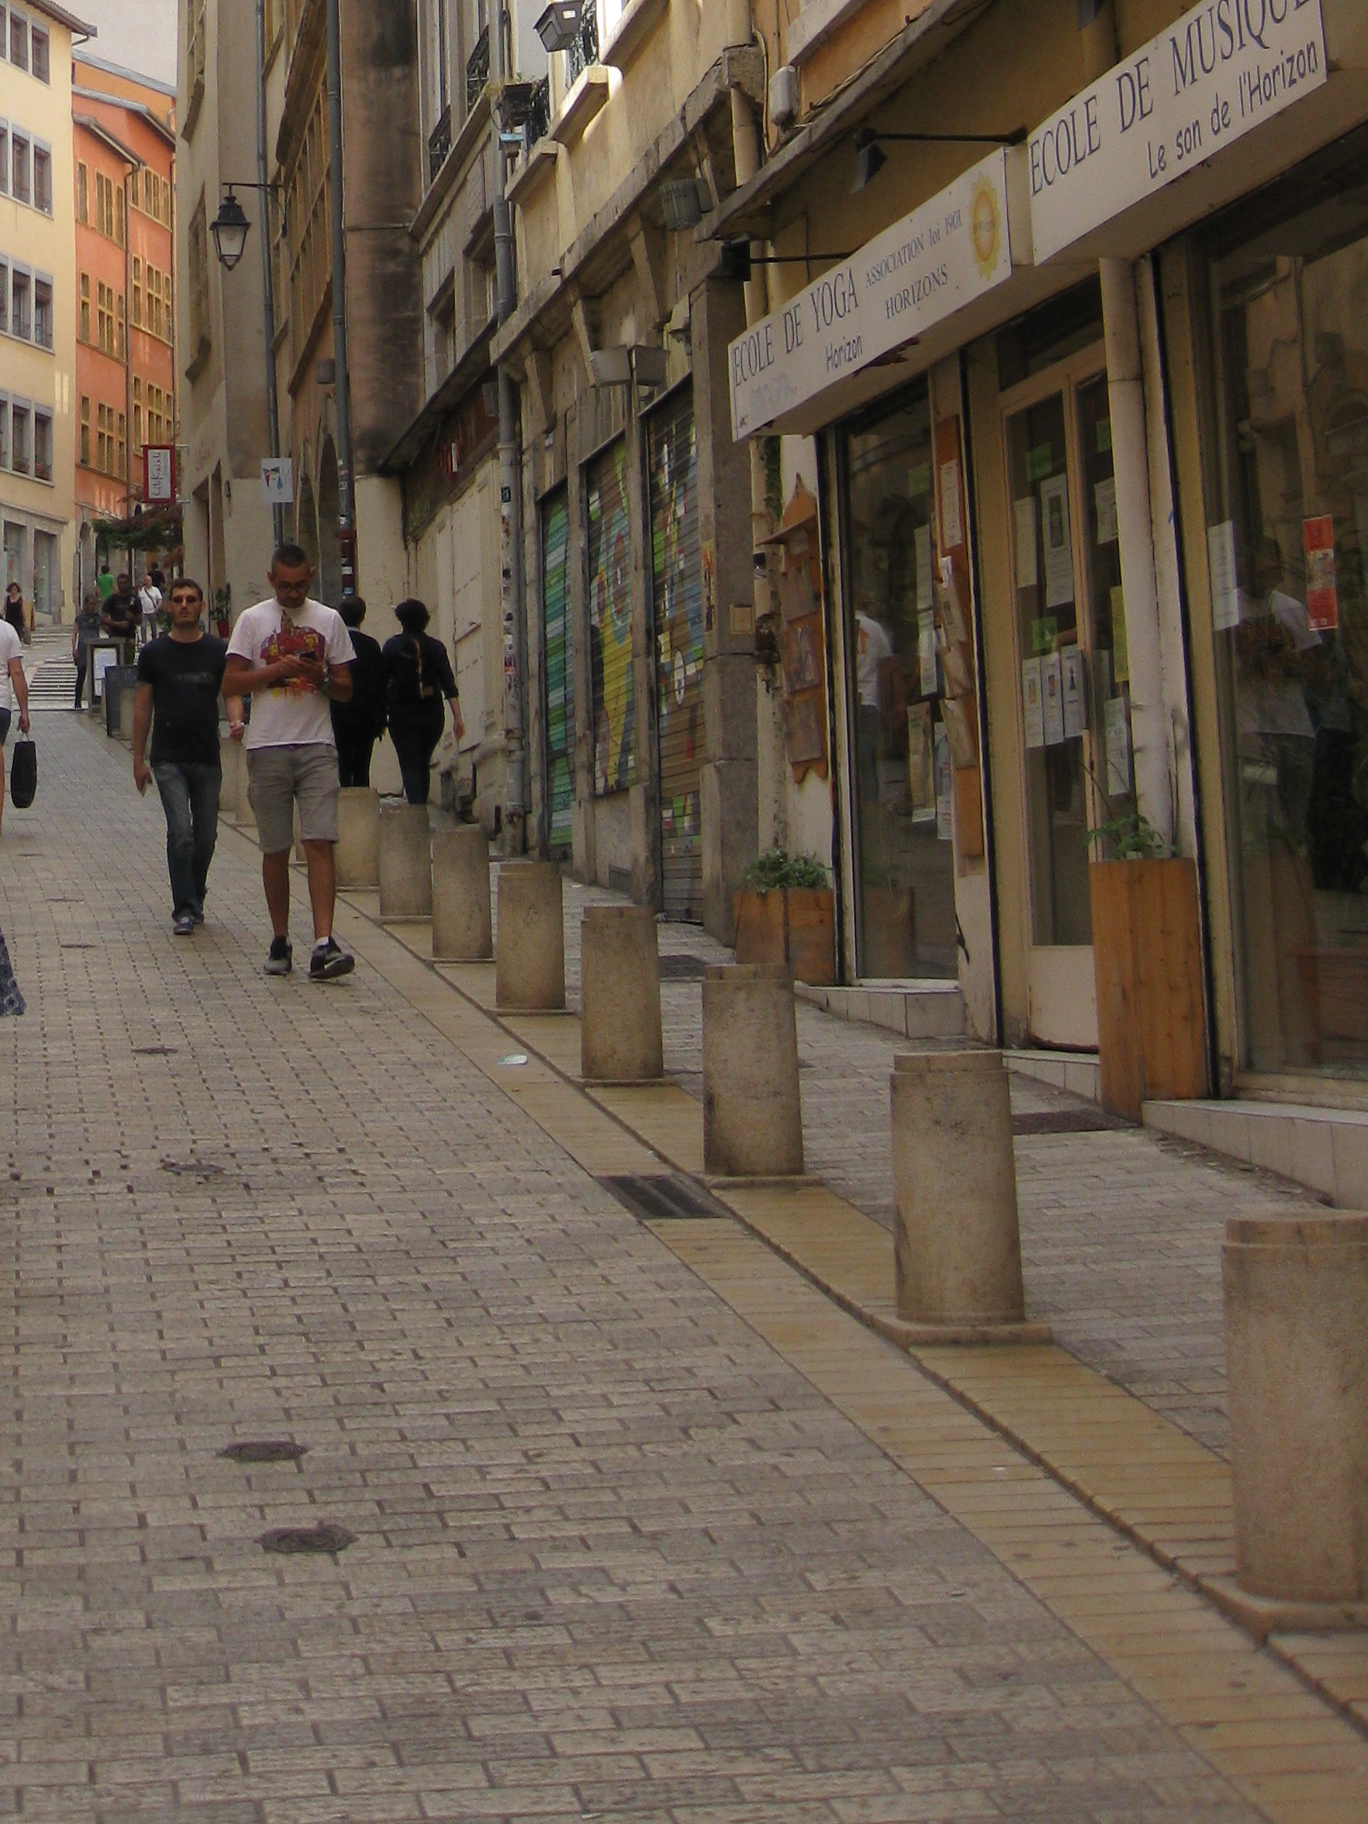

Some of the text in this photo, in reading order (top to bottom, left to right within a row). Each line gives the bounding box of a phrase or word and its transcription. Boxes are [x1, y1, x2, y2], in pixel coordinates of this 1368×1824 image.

[1030, 95, 1101, 196] ECOLE
[1116, 57, 1154, 134] DE
[1147, 40, 1318, 179] Le son de l'Horizon
[865, 233, 925, 289] ASSOCIATION
[928, 227, 941, 248] loi
[944, 209, 962, 236] 1901
[885, 264, 949, 319] HORIZONS
[733, 264, 859, 388] ECOLE DE YOGA
[825, 335, 863, 373] Horizon
